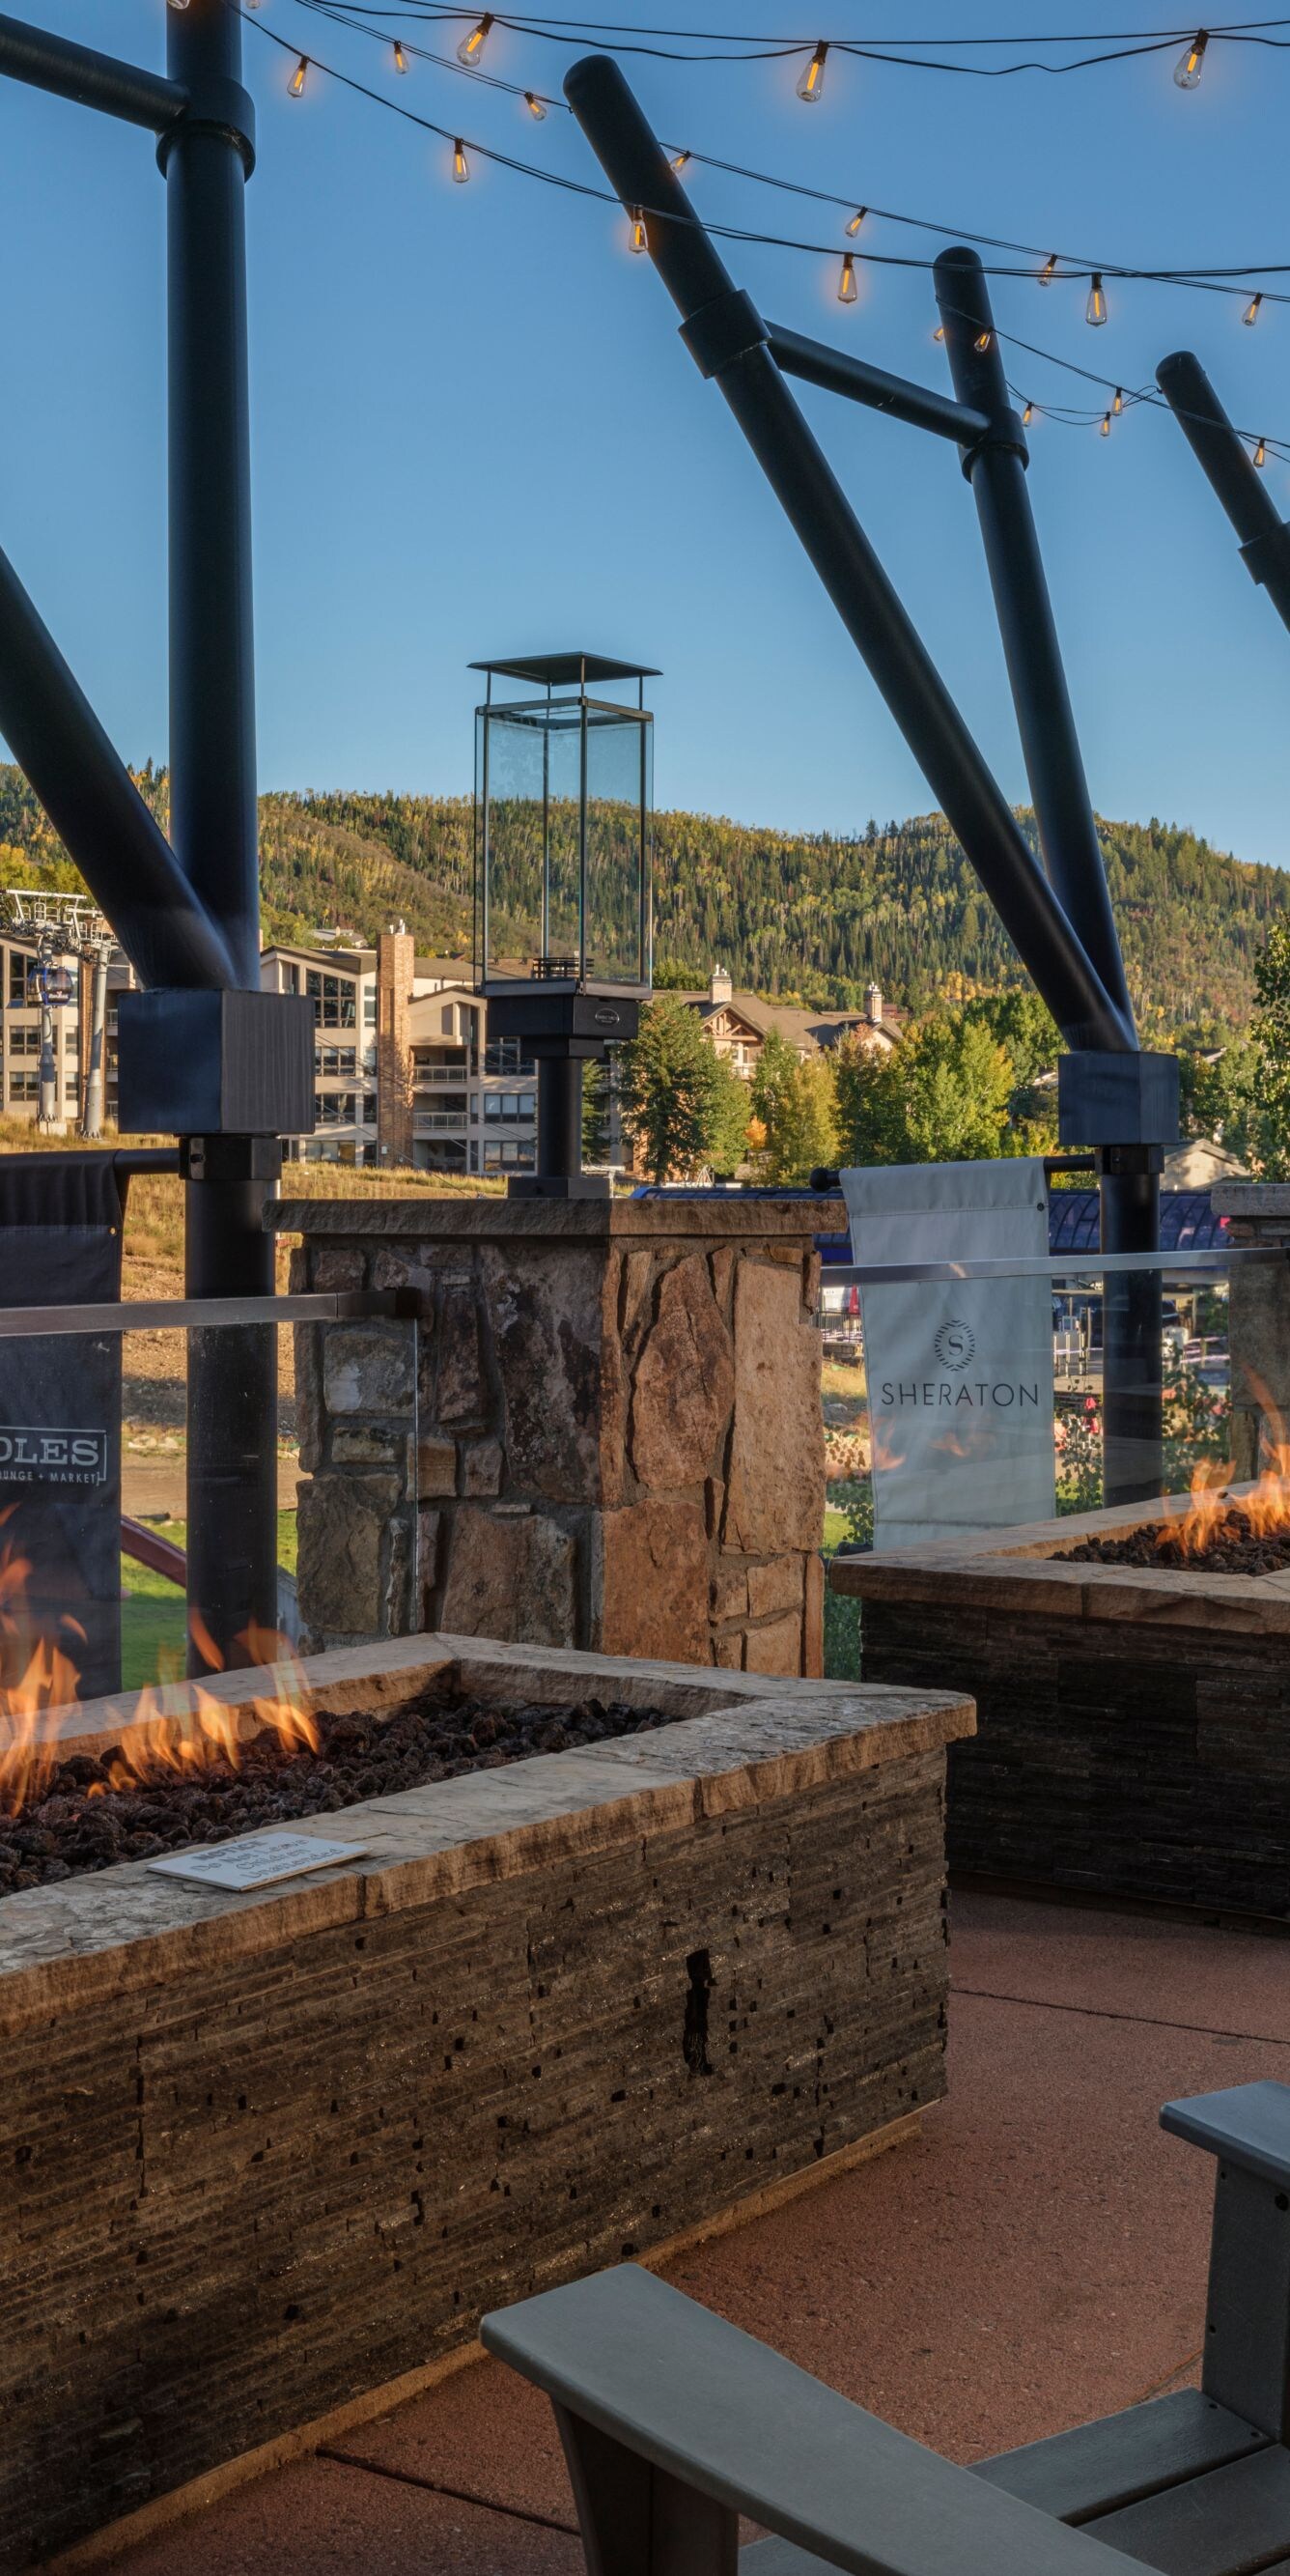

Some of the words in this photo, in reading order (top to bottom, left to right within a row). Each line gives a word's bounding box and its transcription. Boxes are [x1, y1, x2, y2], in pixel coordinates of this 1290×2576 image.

[881, 1382, 1039, 1407] SHERATON
[0, 1470, 34, 1481] UNGE
[190, 1862, 222, 1872] Do
[219, 1853, 259, 1864] Not
[254, 1839, 309, 1854] Leave
[191, 1840, 268, 1860] NOTICE
[236, 1849, 311, 1870] Children
[239, 1848, 345, 1879] Unattended
